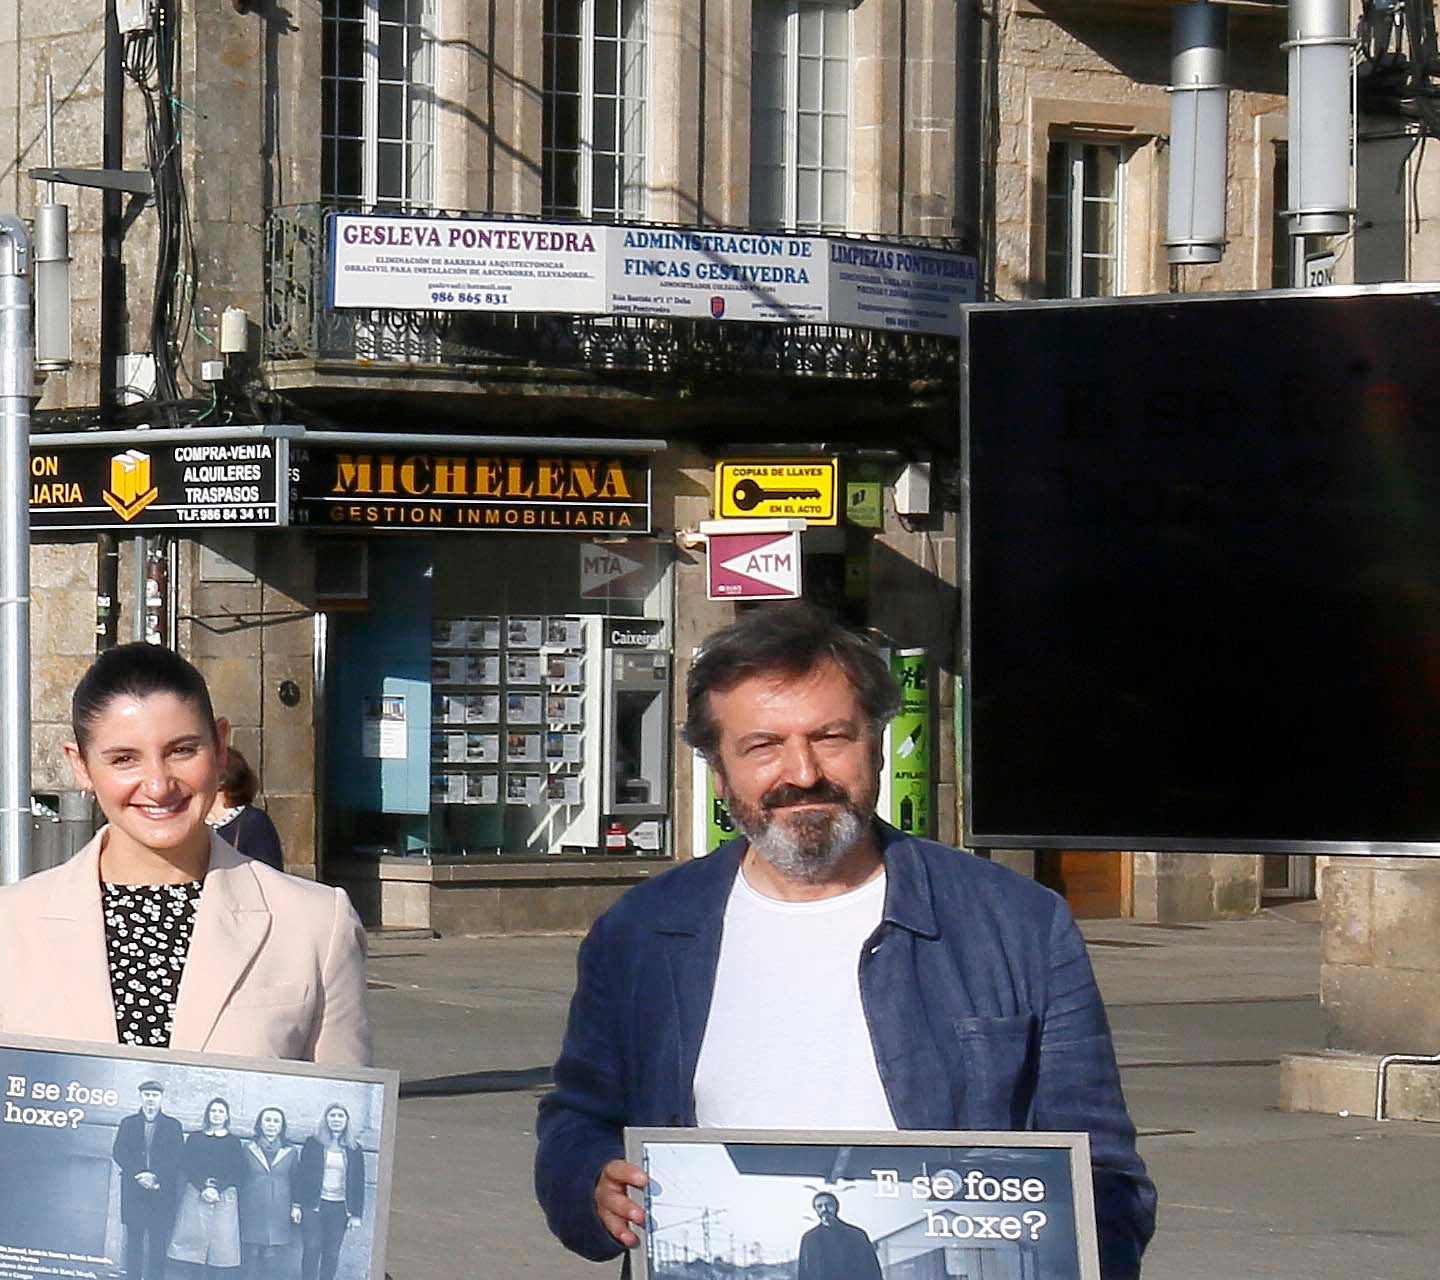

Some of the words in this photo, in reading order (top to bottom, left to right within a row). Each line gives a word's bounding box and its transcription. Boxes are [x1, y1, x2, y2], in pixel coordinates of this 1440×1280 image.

[343, 224, 442, 247] GESLEVA
[448, 229, 595, 252] PONTEVEDRA
[624, 231, 783, 256] ADMINISTRACIÓN
[789, 241, 811, 258] DE
[832, 244, 893, 269] LIMPIEZAS
[624, 259, 690, 278] FINCAS
[696, 264, 809, 284] GESTIVEDRA
[431, 292, 454, 303] 986
[458, 292, 481, 304] 865
[485, 292, 507, 304] 831
[174, 444, 272, 462] COMPRA-VENTA
[184, 465, 262, 483] ALQUILERES
[332, 453, 631, 498] MICHELENA
[732, 468, 768, 477] COPIAS
[770, 468, 785, 477] DE
[786, 467, 823, 477] LLAVES
[185, 486, 260, 503] TRASPASOS
[222, 508, 237, 521] 84
[239, 508, 253, 520] 34
[258, 508, 270, 519] 11
[331, 506, 442, 522] GESTION
[458, 509, 632, 526] INMOBILIARIA
[769, 505, 782, 513] EN
[783, 505, 795, 513] EL
[797, 505, 822, 513] ACTO
[746, 554, 791, 573] ATM
[5, 1076, 26, 1098] E
[31, 1082, 59, 1101] se
[65, 1082, 118, 1106] fose
[4, 1101, 85, 1130] hoxe?
[871, 1169, 899, 1198] E
[911, 1177, 955, 1201] se
[963, 1171, 1045, 1202] fose
[923, 1209, 1047, 1241] hoxe?
